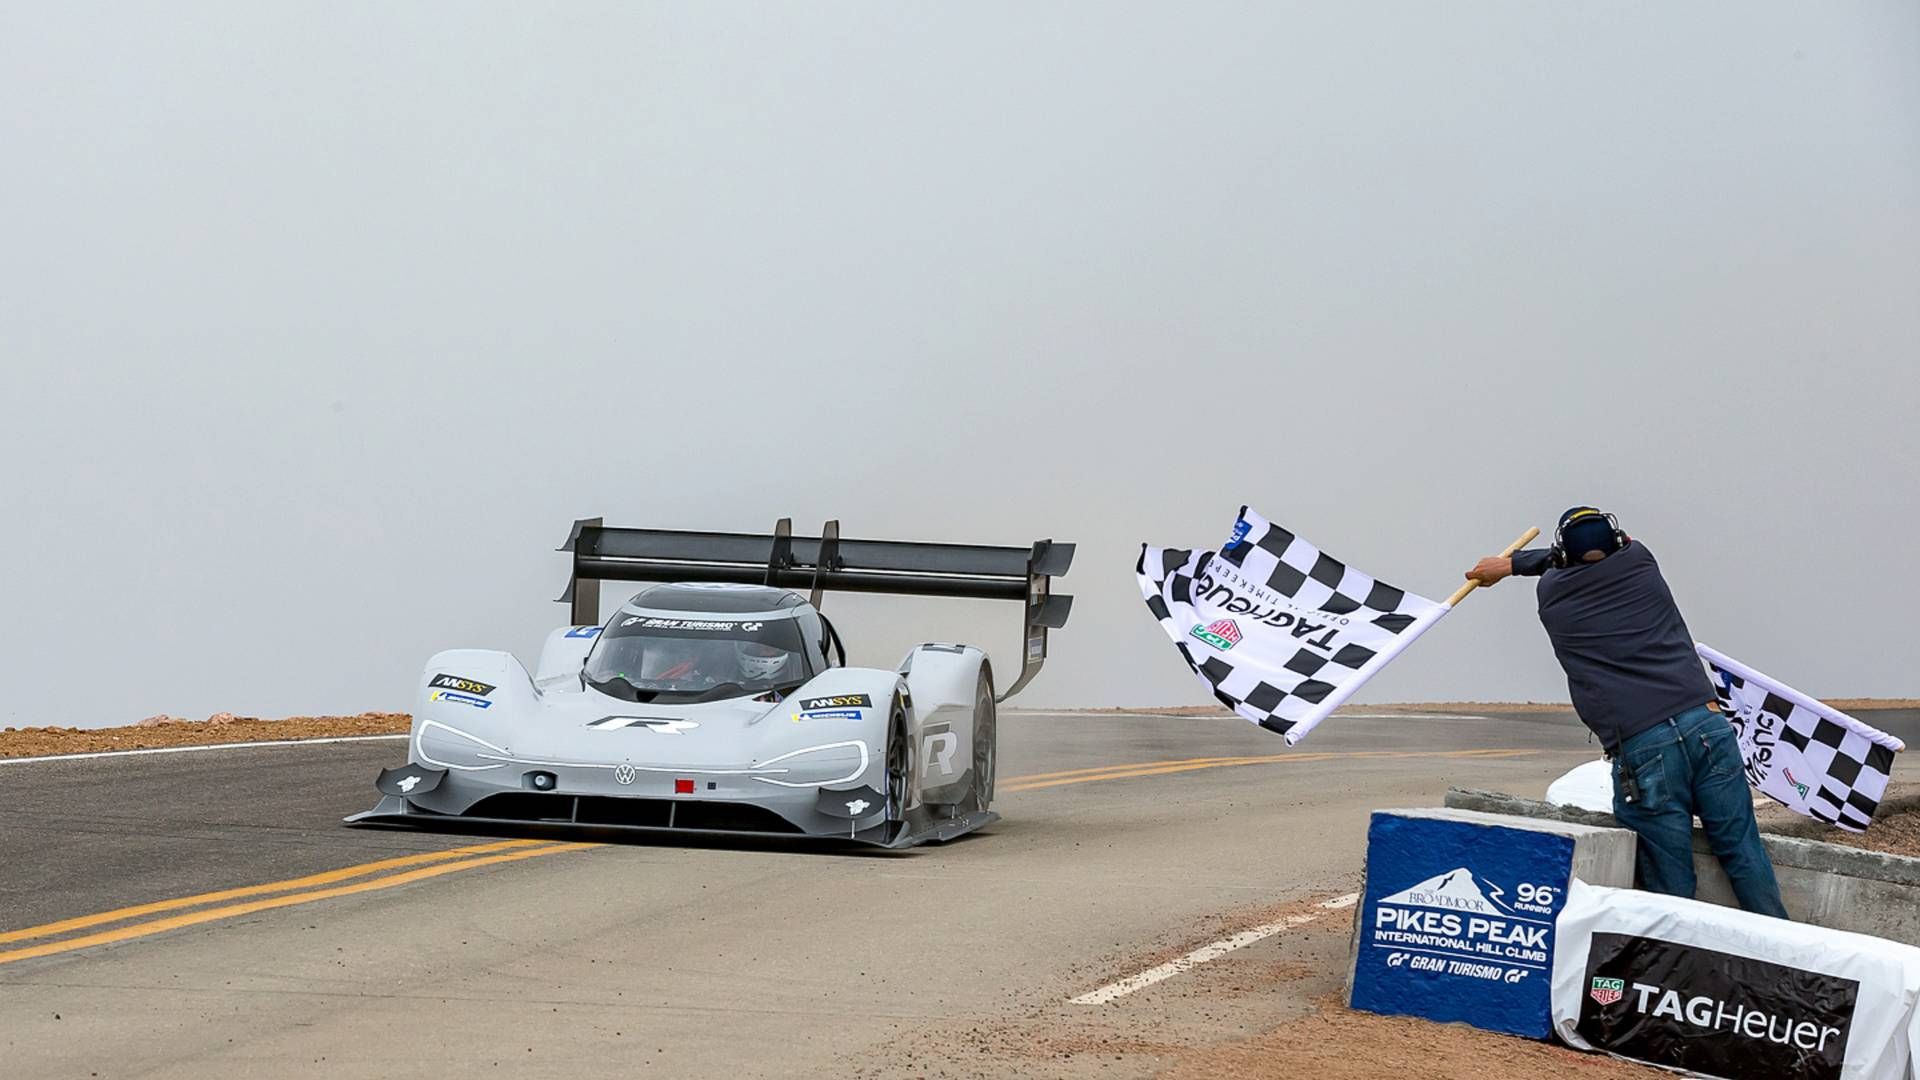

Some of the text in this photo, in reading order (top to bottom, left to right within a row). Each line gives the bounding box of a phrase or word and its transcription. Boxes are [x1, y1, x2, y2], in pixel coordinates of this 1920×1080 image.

[436, 677, 487, 693] ANSYS
[809, 696, 862, 708] ANSYS
[1514, 902, 1552, 915] RUNNING
[1376, 907, 1549, 949] PIKES PEAK
[1375, 930, 1547, 962] INTERNATIONAL HILL CLIMB
[1410, 955, 1446, 972] GRAN
[1449, 961, 1502, 980] TURISMO
[1594, 980, 1621, 990] TAG
